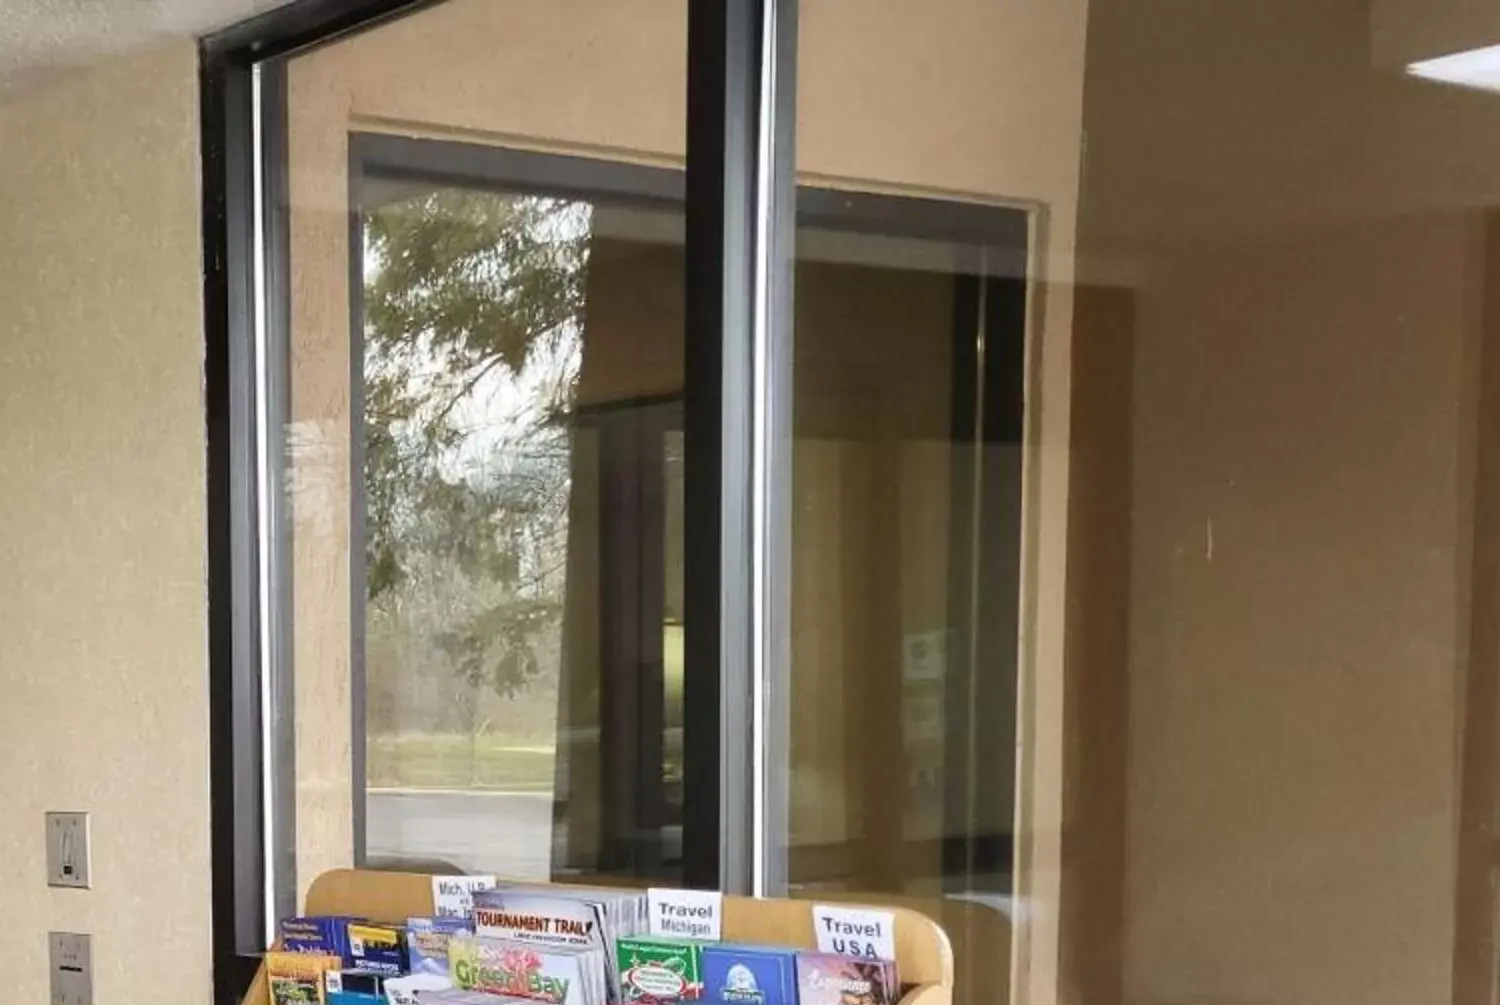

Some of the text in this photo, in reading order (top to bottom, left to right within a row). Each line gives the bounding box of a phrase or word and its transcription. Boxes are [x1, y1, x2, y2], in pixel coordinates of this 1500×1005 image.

[659, 903, 713, 919] Travel
[477, 911, 550, 932] TOURNAMENT
[661, 917, 712, 936] Michigan
[822, 917, 882, 937] Travel
[529, 970, 571, 1003] Bay
